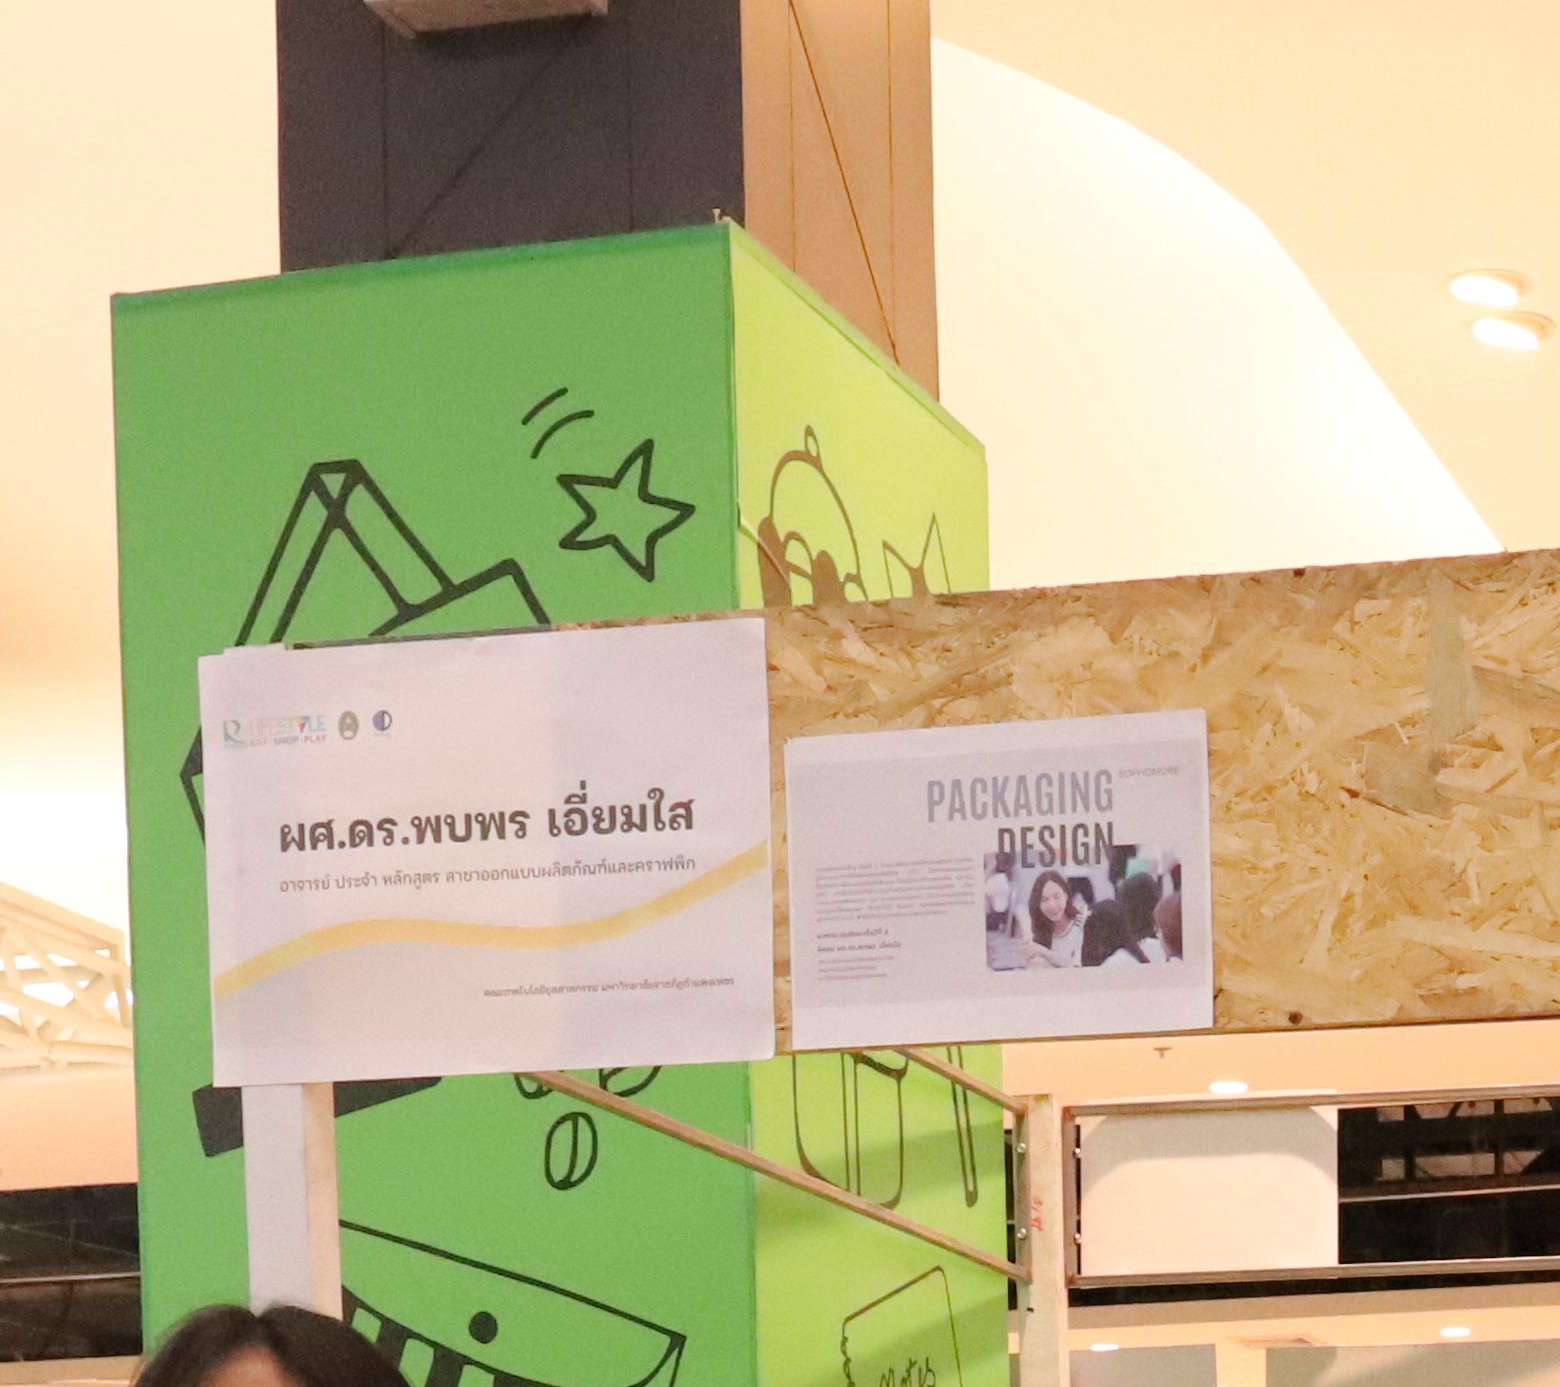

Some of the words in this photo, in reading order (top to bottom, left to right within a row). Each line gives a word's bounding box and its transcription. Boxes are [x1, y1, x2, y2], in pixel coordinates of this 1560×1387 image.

[546, 780, 696, 838] เอี่ยมใส
[927, 769, 1113, 823] PACKAGING
[997, 821, 1113, 868] DESIGN
